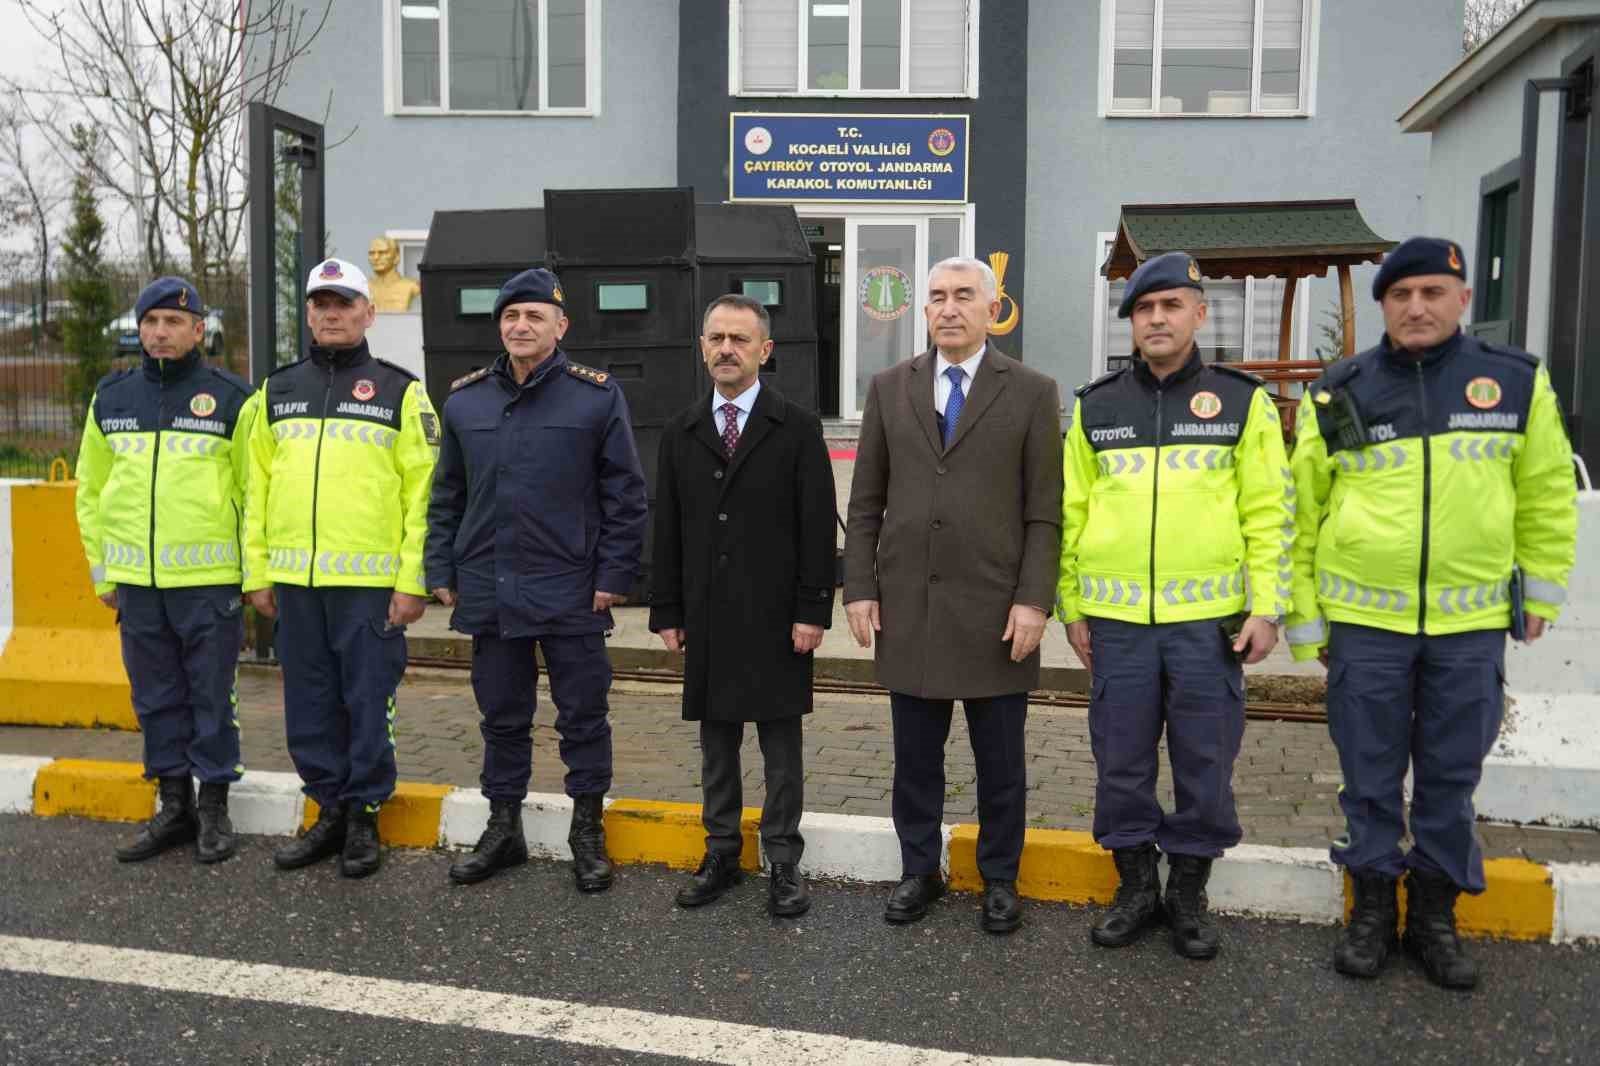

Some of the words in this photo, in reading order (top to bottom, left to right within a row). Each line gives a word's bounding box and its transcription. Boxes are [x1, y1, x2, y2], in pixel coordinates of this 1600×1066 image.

[837, 127, 862, 138] T.C.
[788, 142, 849, 155] KOCAELİ
[852, 142, 911, 156] VALİLİĞİ
[744, 160, 814, 175] ÇAYIRKÖY
[819, 161, 873, 173] OTOYOL
[877, 162, 953, 173] JANDARMA
[767, 178, 832, 190] KARAKOL
[836, 177, 932, 191] KOMUTANLIĞI
[1091, 426, 1137, 442] OTOYOL
[1171, 422, 1240, 437] JANDARMASI
[1368, 422, 1397, 442] YOL
